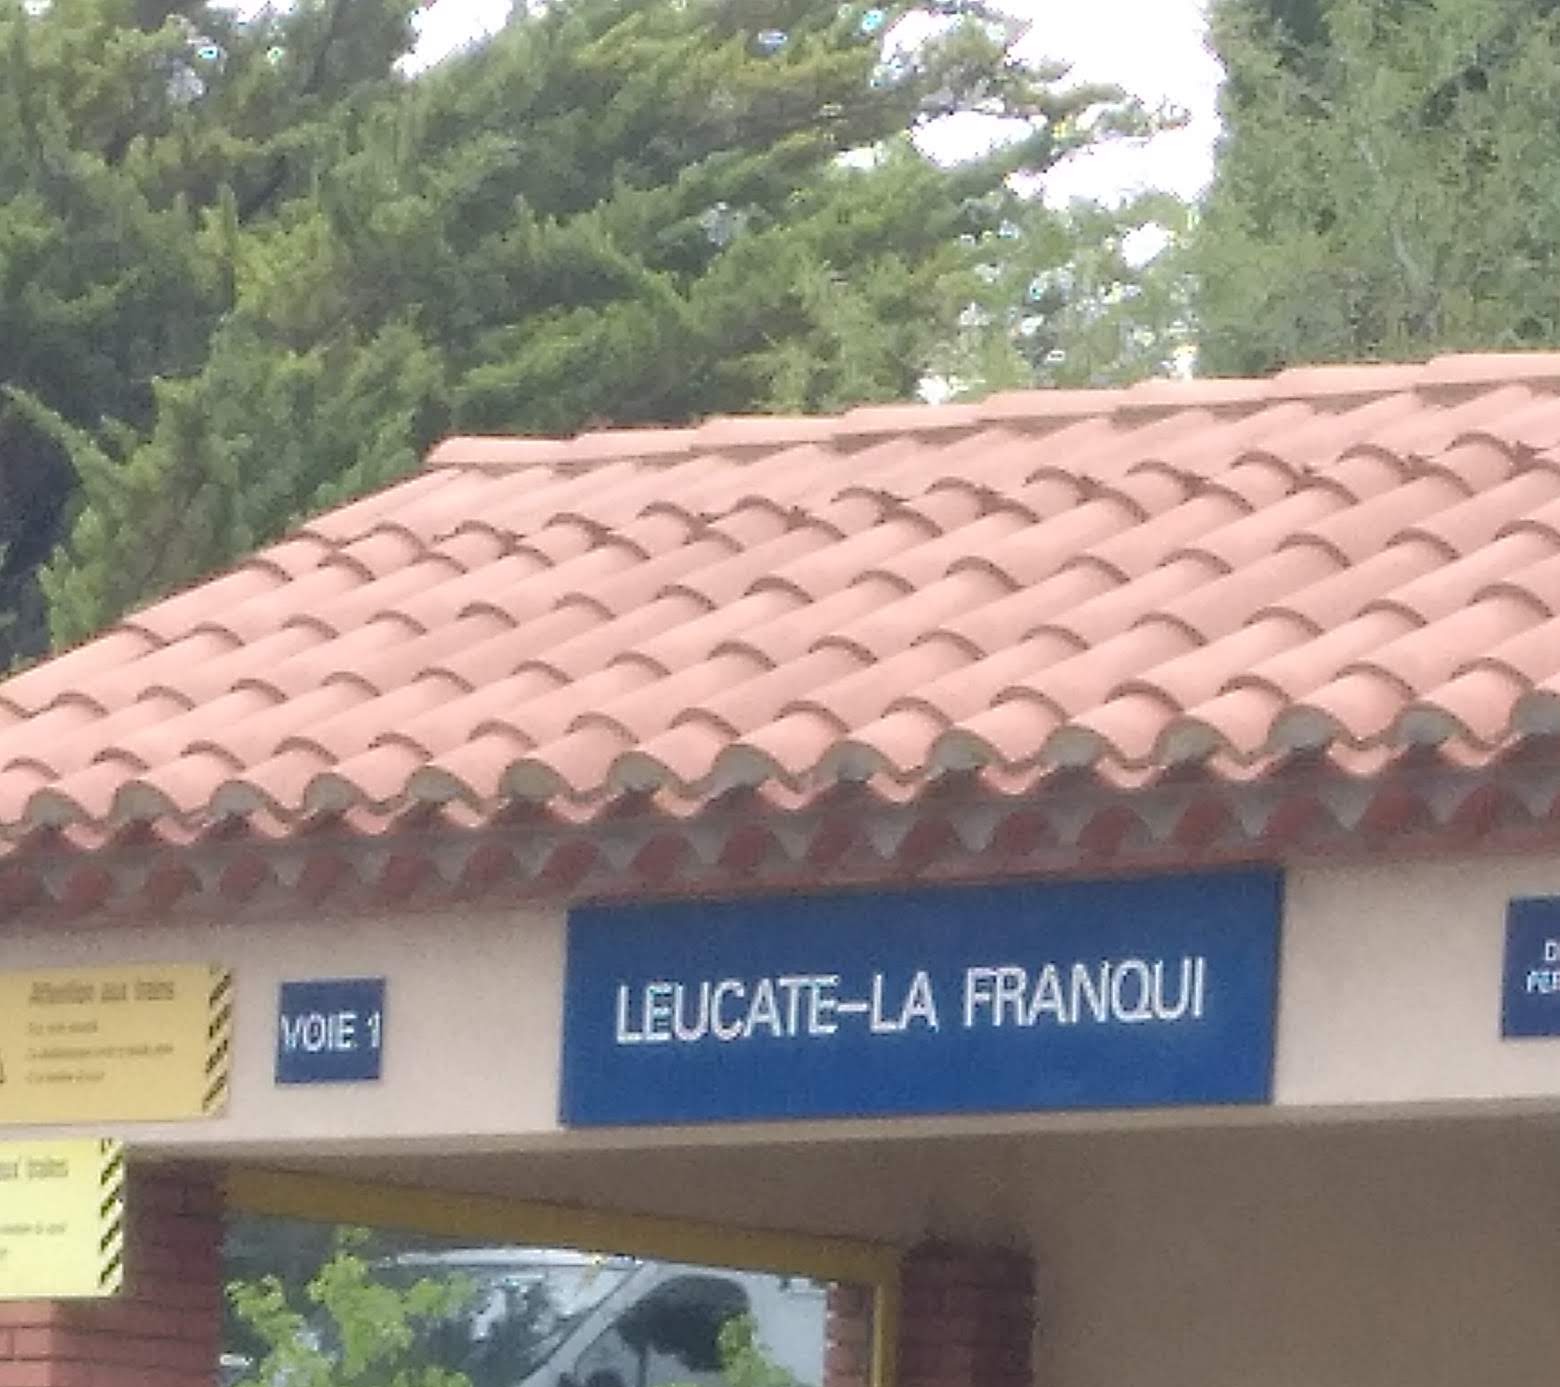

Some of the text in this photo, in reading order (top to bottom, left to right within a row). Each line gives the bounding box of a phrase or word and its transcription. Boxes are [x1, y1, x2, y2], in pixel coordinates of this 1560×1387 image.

[963, 956, 1205, 1028] FRANQUI
[281, 1010, 380, 1051] VOIE 1
